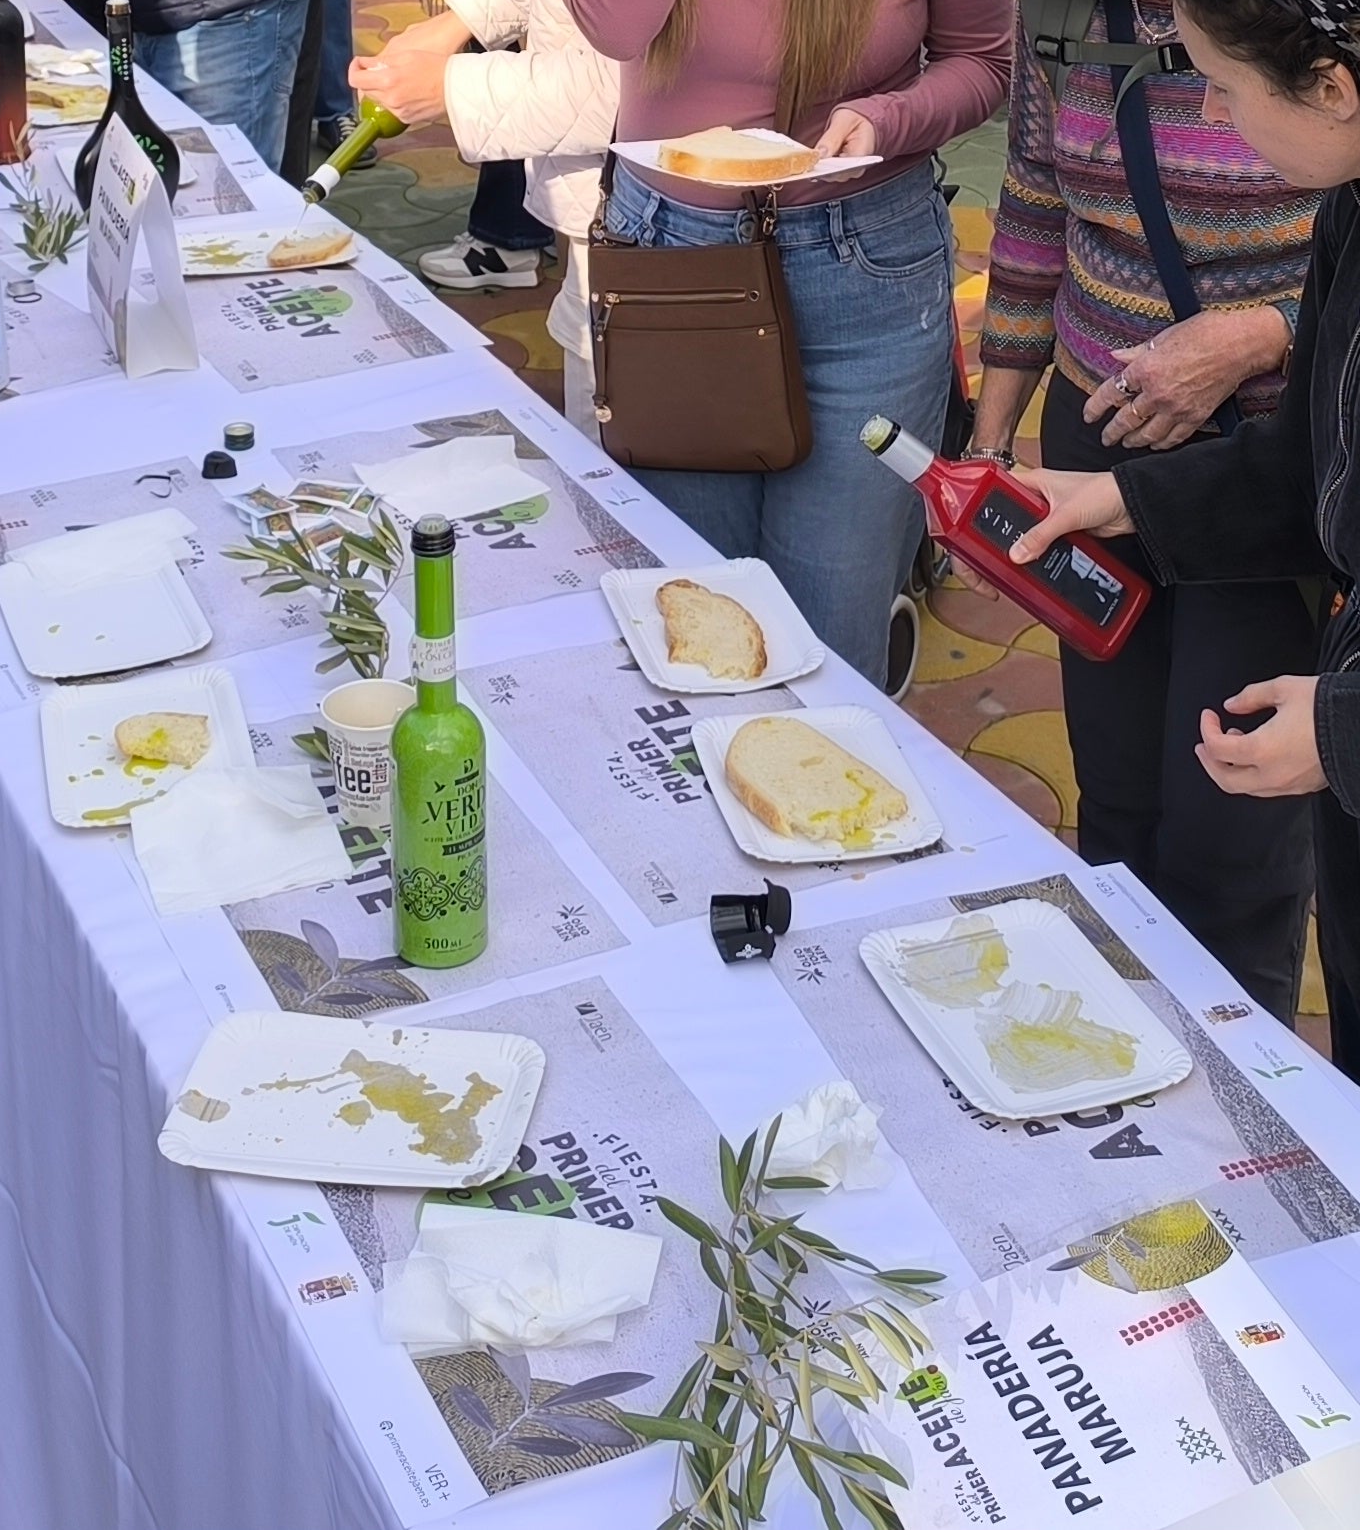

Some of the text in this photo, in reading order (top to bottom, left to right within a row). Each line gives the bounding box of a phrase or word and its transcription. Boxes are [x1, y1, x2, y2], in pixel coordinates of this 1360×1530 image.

[237, 296, 286, 332] PRIMER
[245, 278, 341, 338] ACEITE
[457, 782, 479, 797] DON
[627, 736, 703, 805] PRIMER
[426, 784, 486, 822] VERD
[446, 809, 486, 835] VID
[424, 937, 450, 950] 500
[942, 1078, 1001, 1131] FIEST
[540, 1131, 635, 1230] PRIMER
[595, 1164, 631, 1189] del
[598, 1133, 658, 1206] FIESTA
[899, 1374, 974, 1468] ACEITE
[964, 1320, 1104, 1515] PANADERÍA
[1026, 1324, 1136, 1465] MARUJA
[424, 1463, 449, 1492] VER
[954, 1485, 981, 1523] FIESTA
[965, 1466, 1007, 1524] PRIMER
